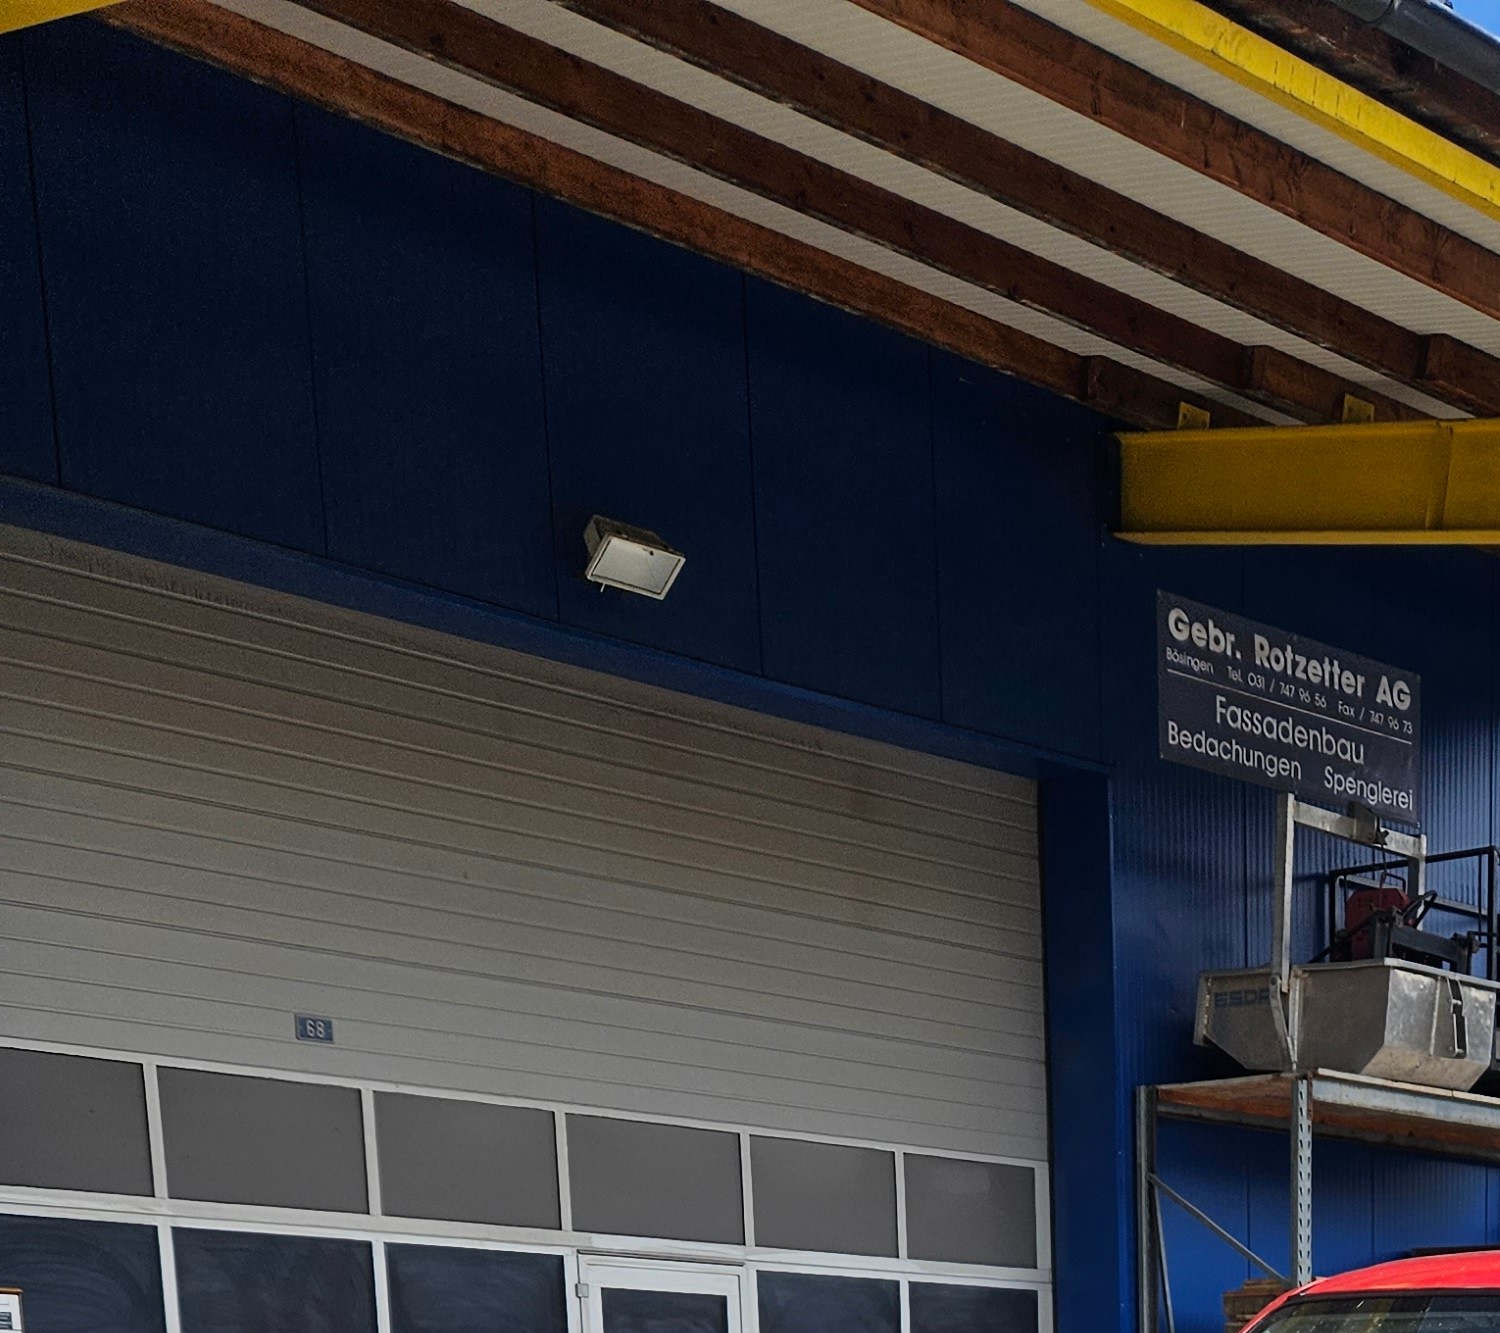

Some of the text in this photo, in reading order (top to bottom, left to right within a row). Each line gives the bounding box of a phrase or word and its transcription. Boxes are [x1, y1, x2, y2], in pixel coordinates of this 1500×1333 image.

[1166, 646, 1214, 674] Bösingen
[1247, 672, 1265, 690] 031
[1279, 682, 1295, 698] 747
[1299, 688, 1311, 703] 96
[1314, 693, 1327, 708] 56
[1338, 700, 1355, 717] Fax
[1369, 710, 1384, 725] 747
[1387, 716, 1399, 730] 96
[1403, 720, 1413, 735] 73
[1168, 607, 1411, 711] Gebr. Rotzetter AG
[1168, 720, 1413, 811] Bedachungen Spenglerei
[1216, 695, 1364, 765] Fassadenbau
[306, 1019, 325, 1038] 68
